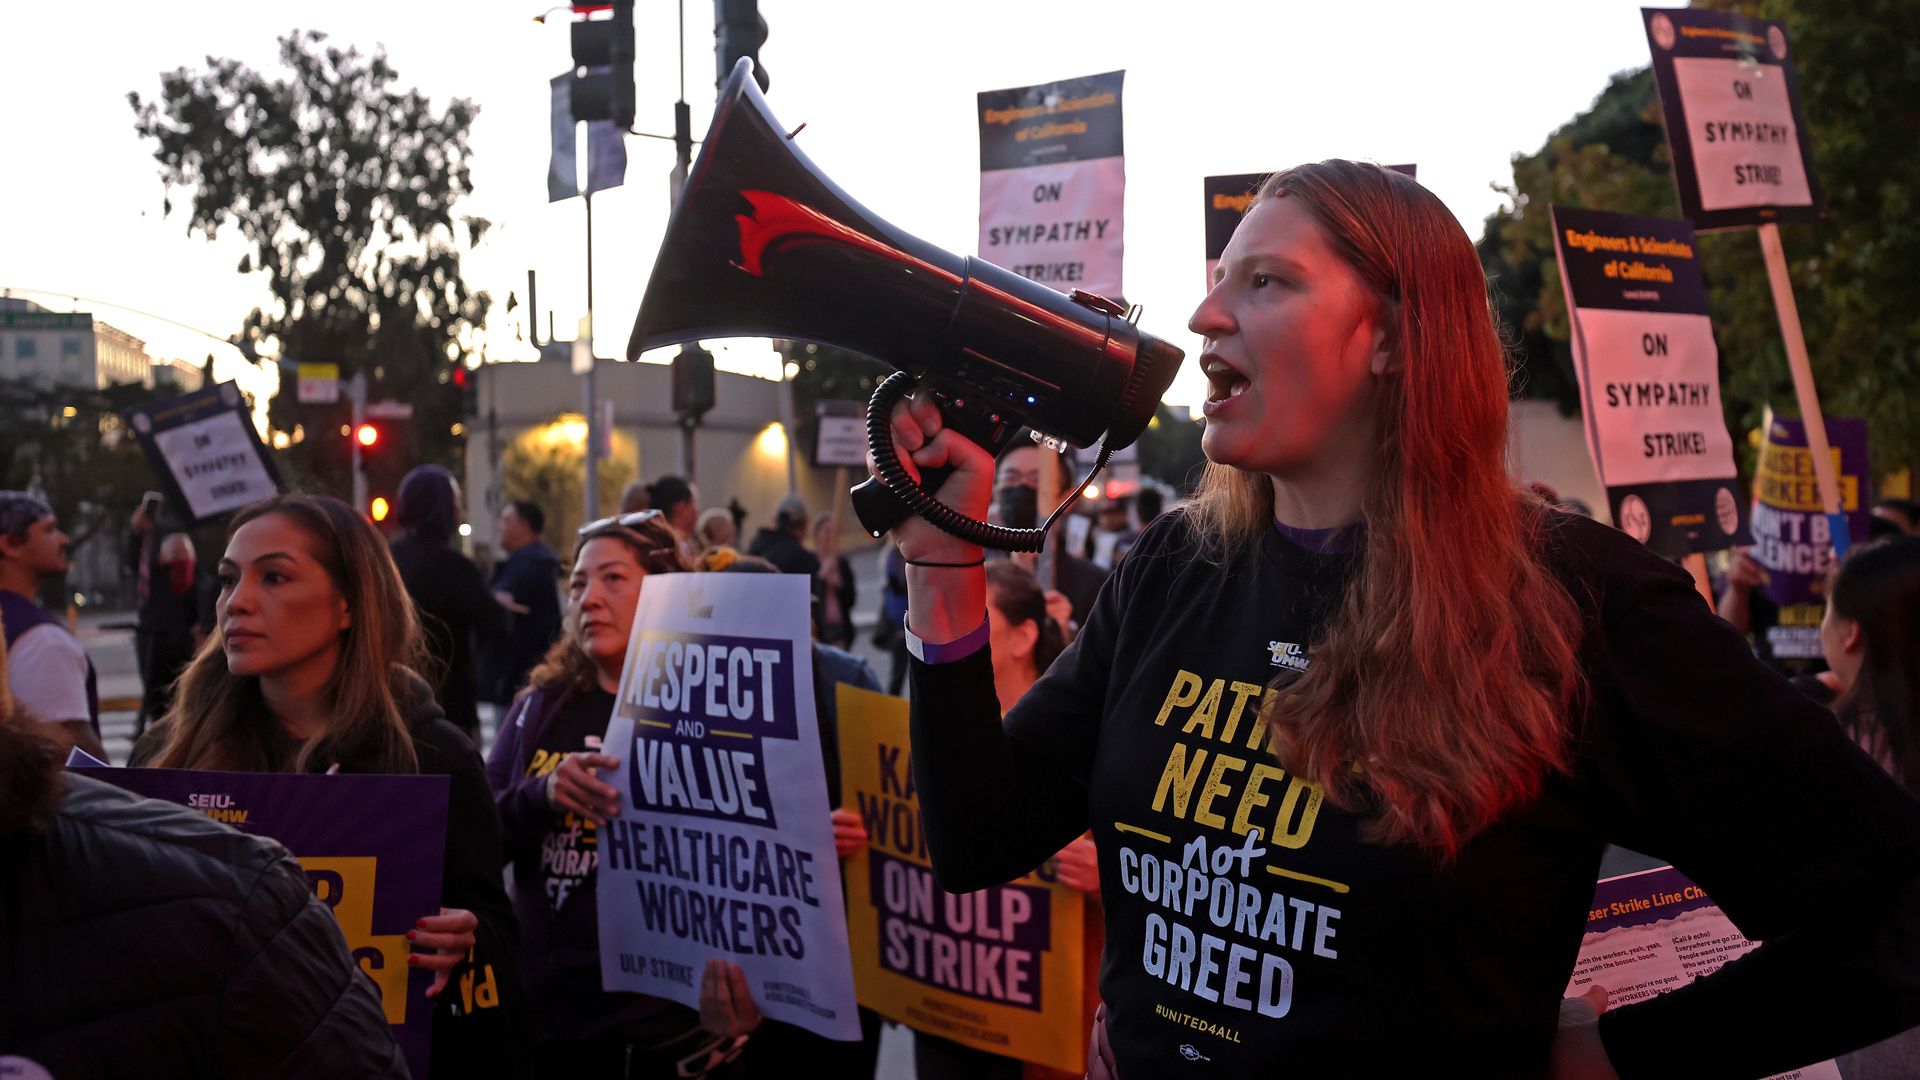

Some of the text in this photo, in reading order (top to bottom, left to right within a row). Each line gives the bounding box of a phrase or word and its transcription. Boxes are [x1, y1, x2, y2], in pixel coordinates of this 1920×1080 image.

[1734, 80, 1752, 99] ON
[1706, 122, 1786, 144] SYMPATHY
[1034, 183, 1062, 203] ON
[989, 219, 1109, 246] SYMPATHY
[1566, 229, 1629, 253] Engineers
[1639, 236, 1693, 259] Scientists
[1604, 260, 1674, 283] of California
[1643, 333, 1668, 357] ON
[1606, 383, 1710, 407] SYMPATHY
[1644, 433, 1706, 457] STRIKE!
[627, 639, 780, 723] RESPECT
[675, 720, 705, 739] AND
[637, 737, 767, 820] VALUE
[188, 793, 235, 808] SEIU-
[1151, 742, 1326, 849] NEED
[605, 819, 820, 907] HEALTHCARE
[1182, 829, 1267, 878] not
[882, 860, 1032, 943] ON ULP
[1119, 846, 1342, 959] CORPORATE
[1610, 898, 1651, 917] Strike
[1652, 892, 1682, 908] Line
[636, 879, 805, 960] WORKERS
[1672, 936, 1688, 945] (Call
[1693, 931, 1711, 941] echo)
[1675, 941, 1711, 953] Everywhere
[1730, 932, 1742, 941] (2x)
[885, 916, 1032, 1005] STRIKE
[1577, 942, 1662, 966] with the workers, yeah, yeah,
[1679, 951, 1700, 961] People
[1700, 948, 1716, 956] want
[1723, 943, 1741, 952] know
[1682, 961, 1697, 970] Who
[1717, 954, 1729, 963] (2x)
[620, 953, 694, 987] ULP STRIKE
[1143, 913, 1294, 1019] GREED
[1572, 952, 1658, 977] Down with the bosses, boom,
[1574, 977, 1593, 986] boom
[1607, 985, 1636, 996] ecutives
[1618, 990, 1650, 1003] WORKERS
[1155, 1003, 1241, 1043] #UNITED4ALL
